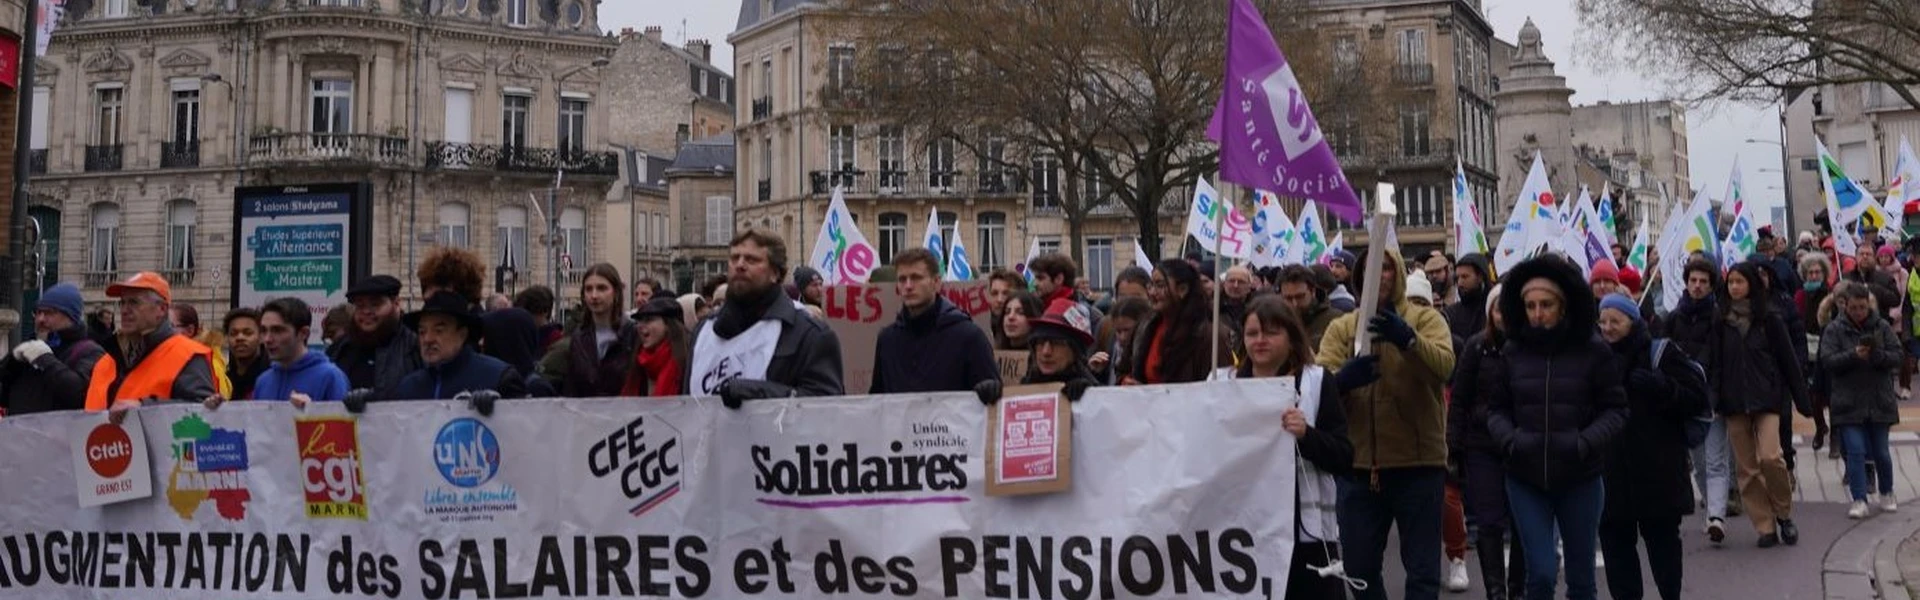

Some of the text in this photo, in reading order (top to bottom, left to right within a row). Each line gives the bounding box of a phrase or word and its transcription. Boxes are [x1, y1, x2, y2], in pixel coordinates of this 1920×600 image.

[255, 200, 338, 213] 2 salons Studyrama
[273, 241, 333, 254] Alternance
[280, 273, 322, 286] Masters
[826, 285, 882, 323] LES
[302, 424, 341, 456] la
[912, 423, 949, 435] Union
[588, 416, 646, 478] CFE
[302, 453, 366, 500] cgt
[621, 438, 679, 499] CGC
[751, 440, 968, 496] Solidaires
[97, 482, 120, 495] GRAND
[436, 505, 470, 515] MARQUE
[472, 503, 518, 514] AUTONOME
[327, 535, 401, 599] des
[418, 535, 711, 600] SALAIRES
[733, 536, 796, 596] et
[814, 539, 918, 597] des
[940, 528, 1272, 600] PENSIONS,
